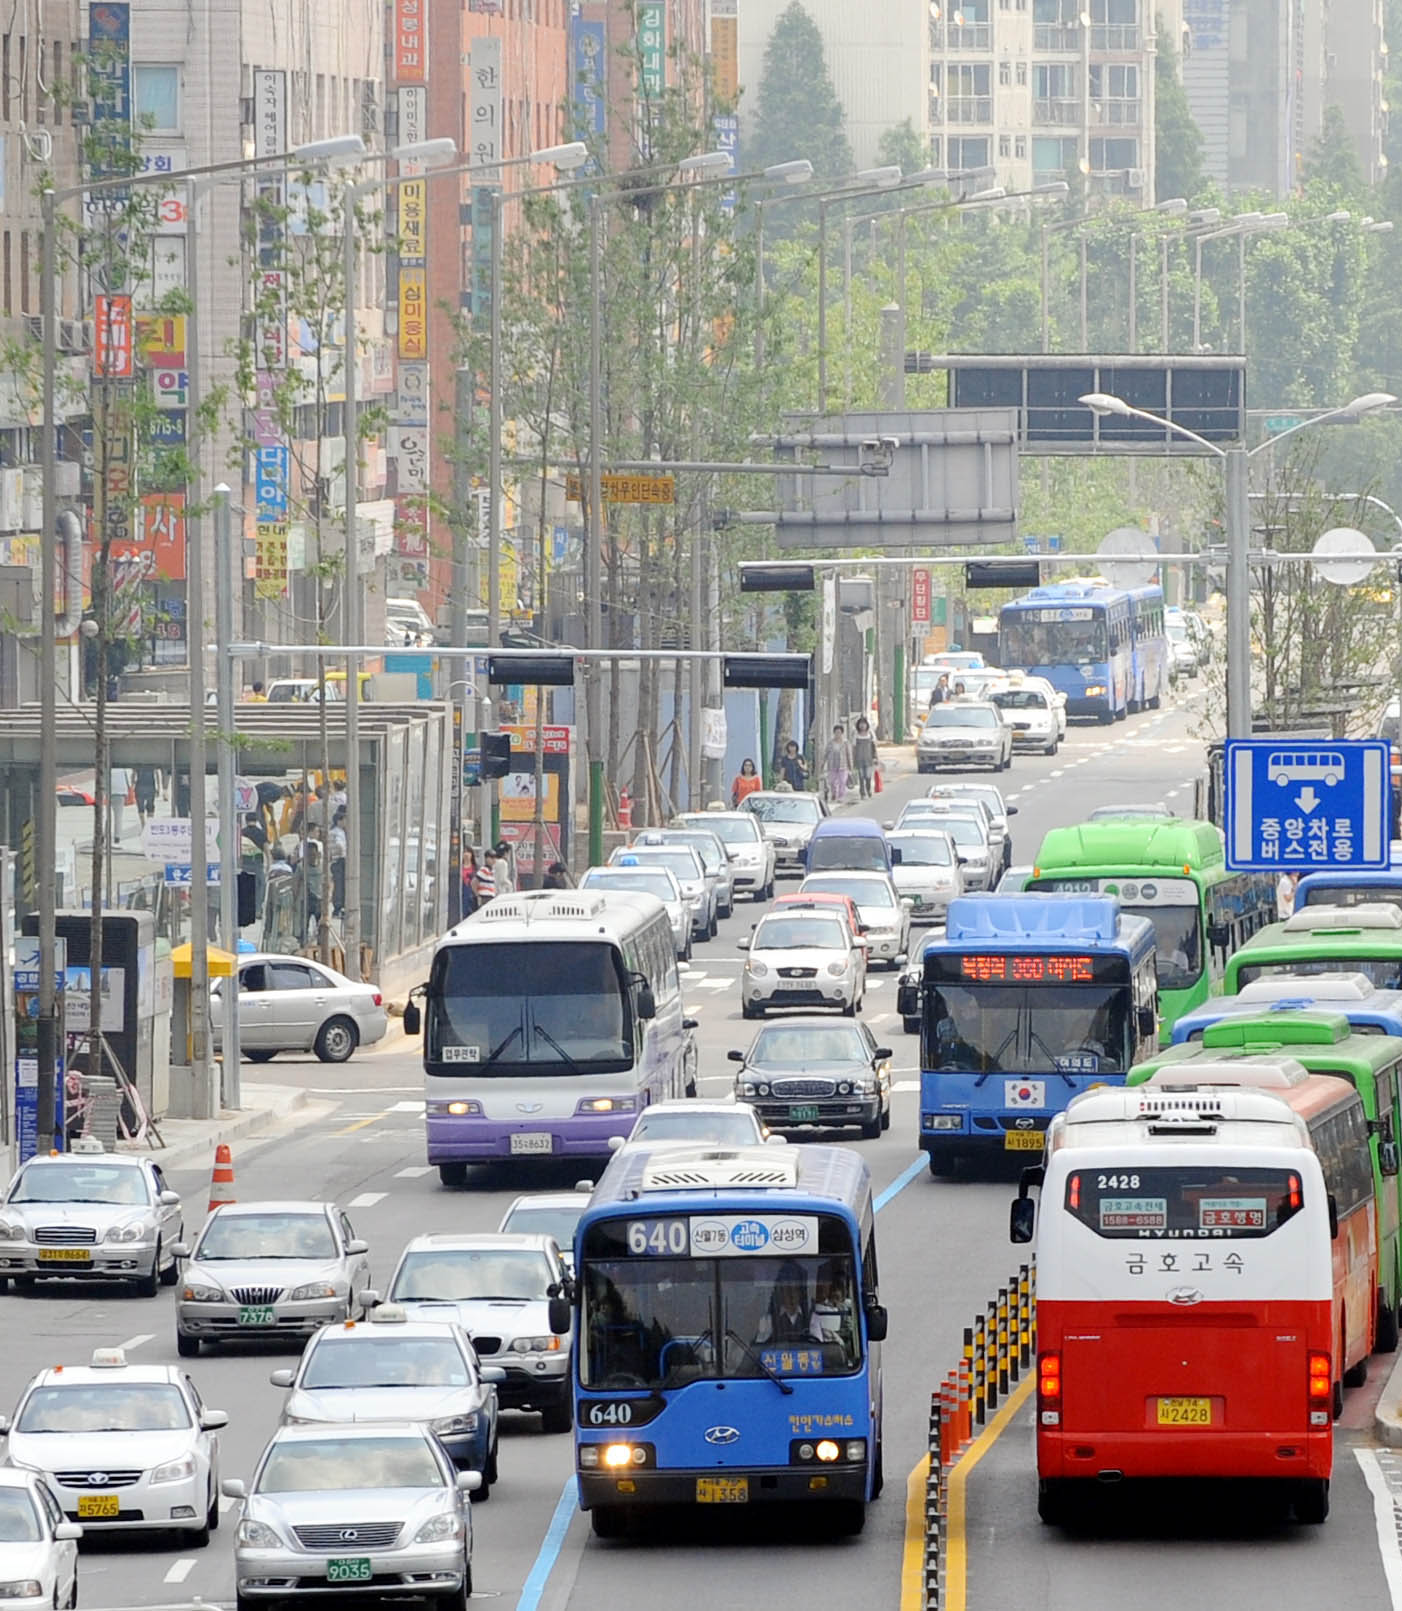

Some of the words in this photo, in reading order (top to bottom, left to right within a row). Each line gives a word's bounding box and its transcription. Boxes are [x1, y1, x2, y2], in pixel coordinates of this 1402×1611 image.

[475, 65, 497, 164] 한의원
[1260, 817, 1354, 841] 중앙차로
[1260, 839, 1354, 861] 버스전용
[1097, 1174, 1141, 1190] 2428
[1203, 1210, 1263, 1227] 금호생명
[628, 1221, 687, 1254] 640
[772, 1228, 807, 1242] 삼성역
[1125, 1252, 1245, 1276] 금호고속
[590, 1403, 631, 1424] 640
[1171, 1408, 1208, 1423] 2428
[88, 1504, 117, 1516] 5765
[329, 1563, 370, 1580] 9035
